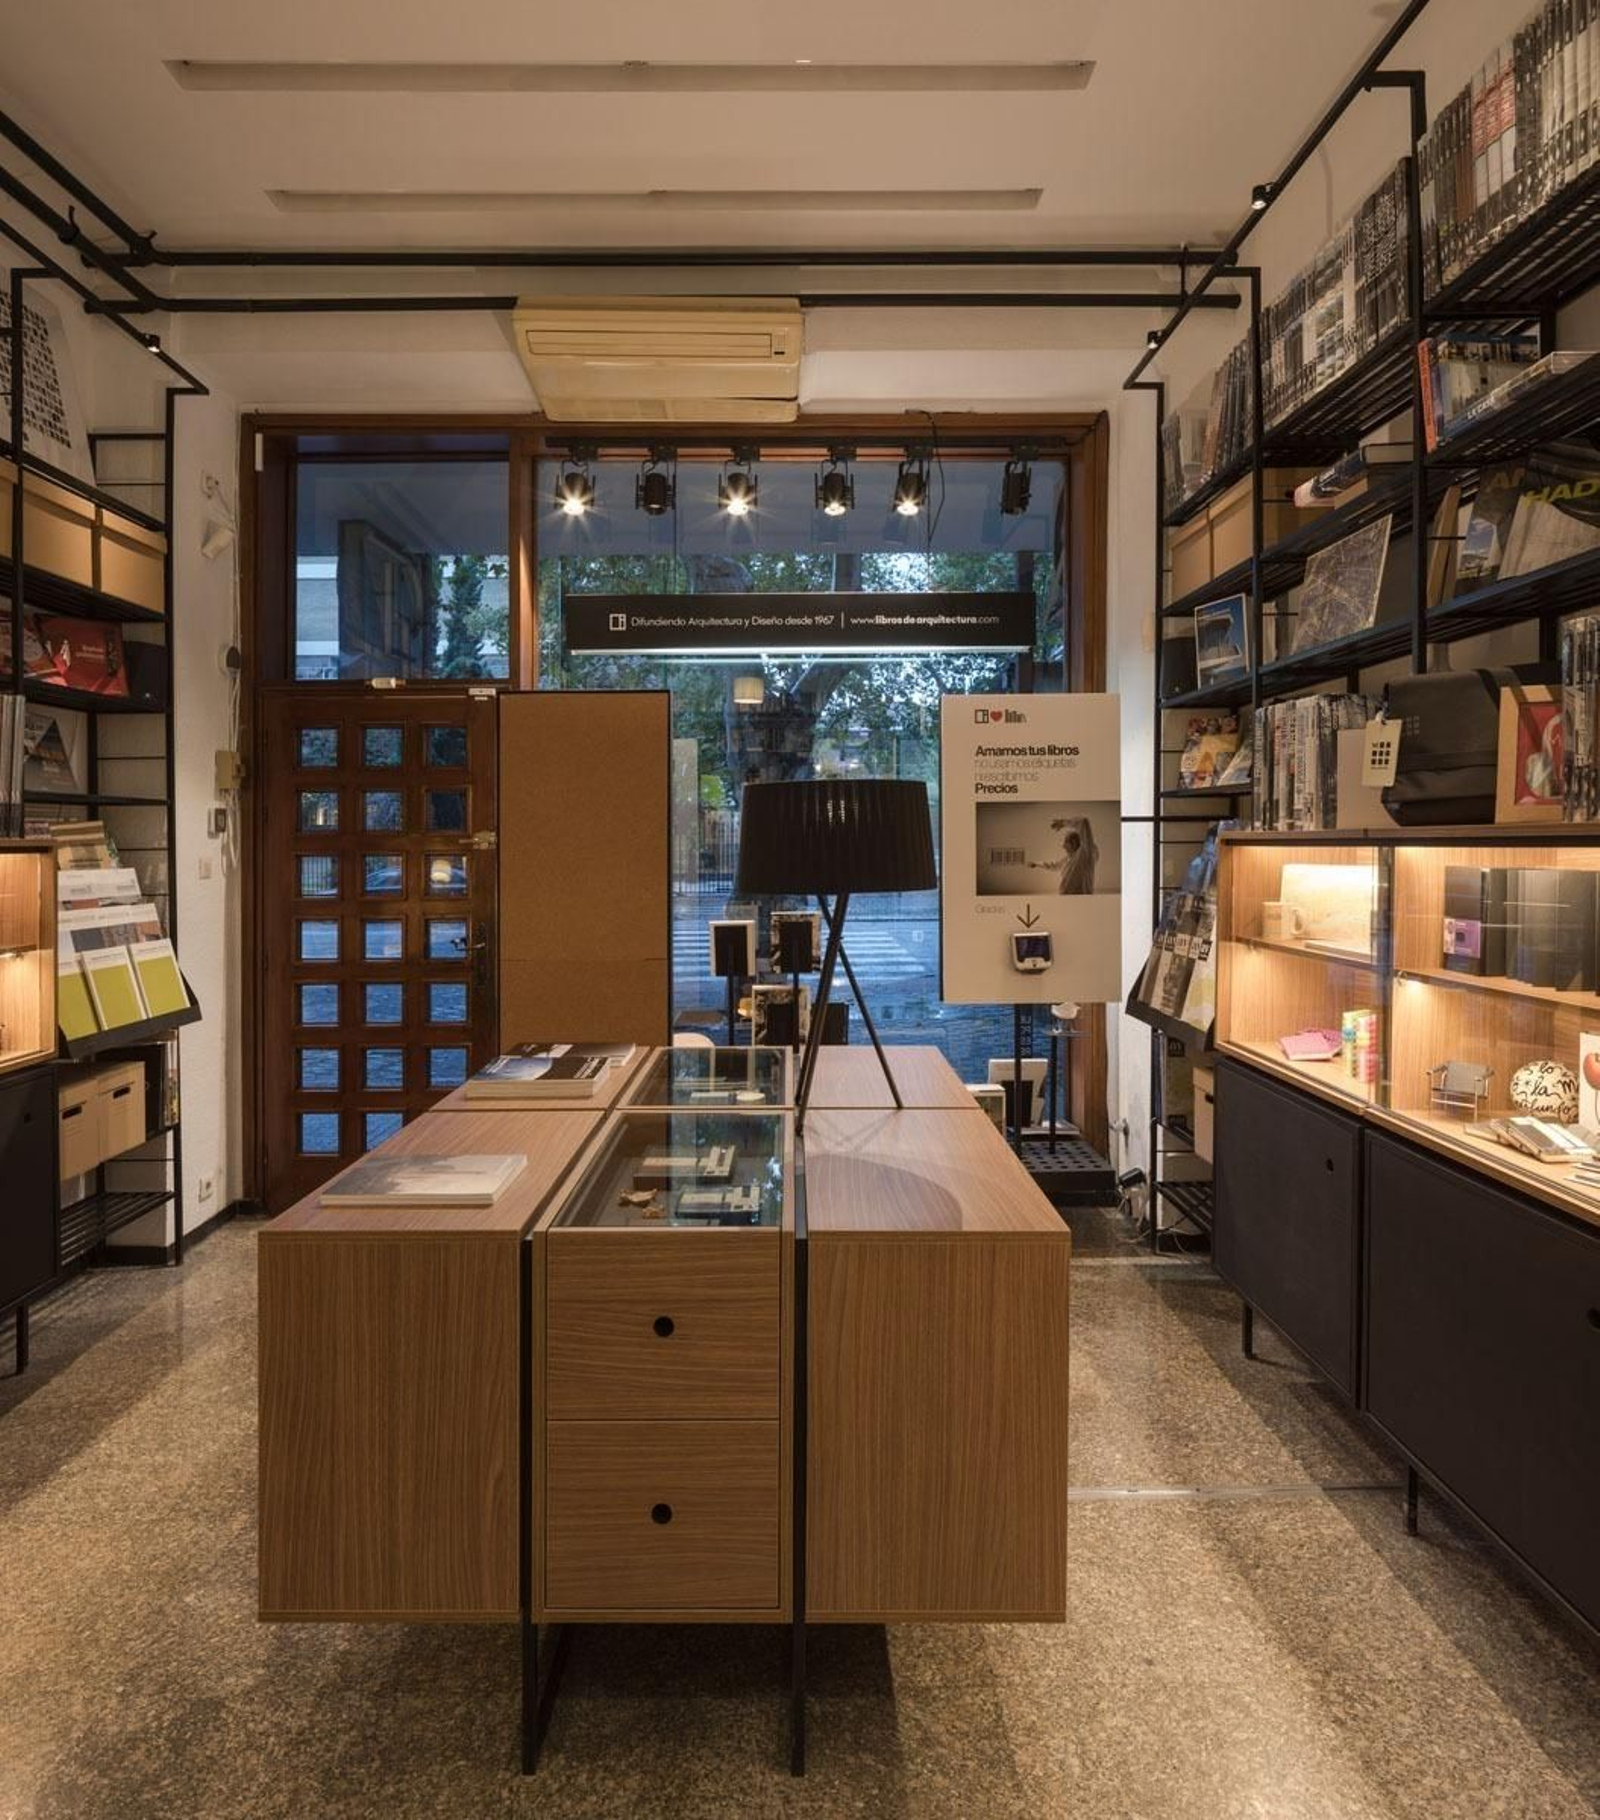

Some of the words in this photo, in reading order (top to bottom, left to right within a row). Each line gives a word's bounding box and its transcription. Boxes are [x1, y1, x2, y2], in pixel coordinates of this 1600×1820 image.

[631, 616, 686, 627] Difundiendo
[688, 616, 743, 628] Arquitectura
[743, 618, 749, 628] y
[751, 615, 783, 626] Diseño
[784, 615, 813, 626] desde
[814, 615, 835, 625] 1967
[850, 615, 1000, 626] www.librosdearquitectura.com
[975, 745, 1028, 757] Amamos
[1029, 746, 1047, 756] tus
[1047, 744, 1080, 756] libros
[974, 782, 1018, 794] Precios
